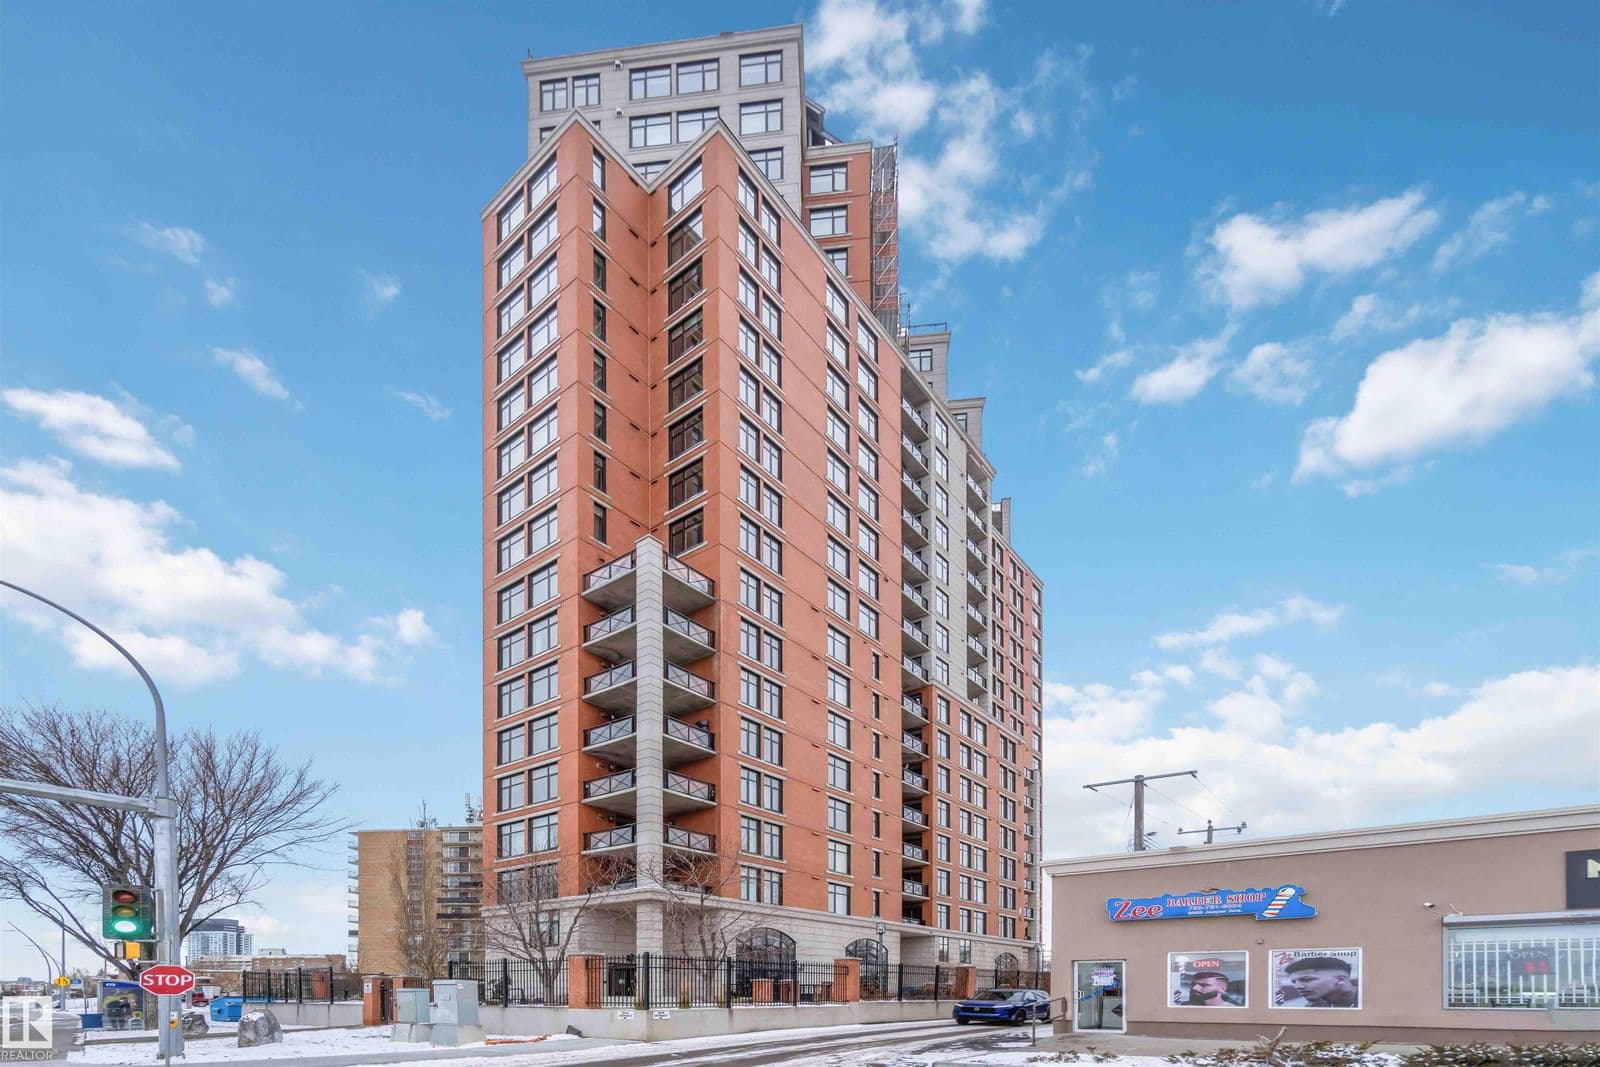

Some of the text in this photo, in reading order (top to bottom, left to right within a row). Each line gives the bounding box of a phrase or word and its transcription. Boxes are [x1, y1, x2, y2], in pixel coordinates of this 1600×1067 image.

[1167, 892, 1266, 907] BARBER SHOP
[1114, 901, 1163, 919] Zee
[1510, 950, 1548, 960] OPEN
[1193, 960, 1219, 968] OPEN
[143, 974, 192, 986] STOP
